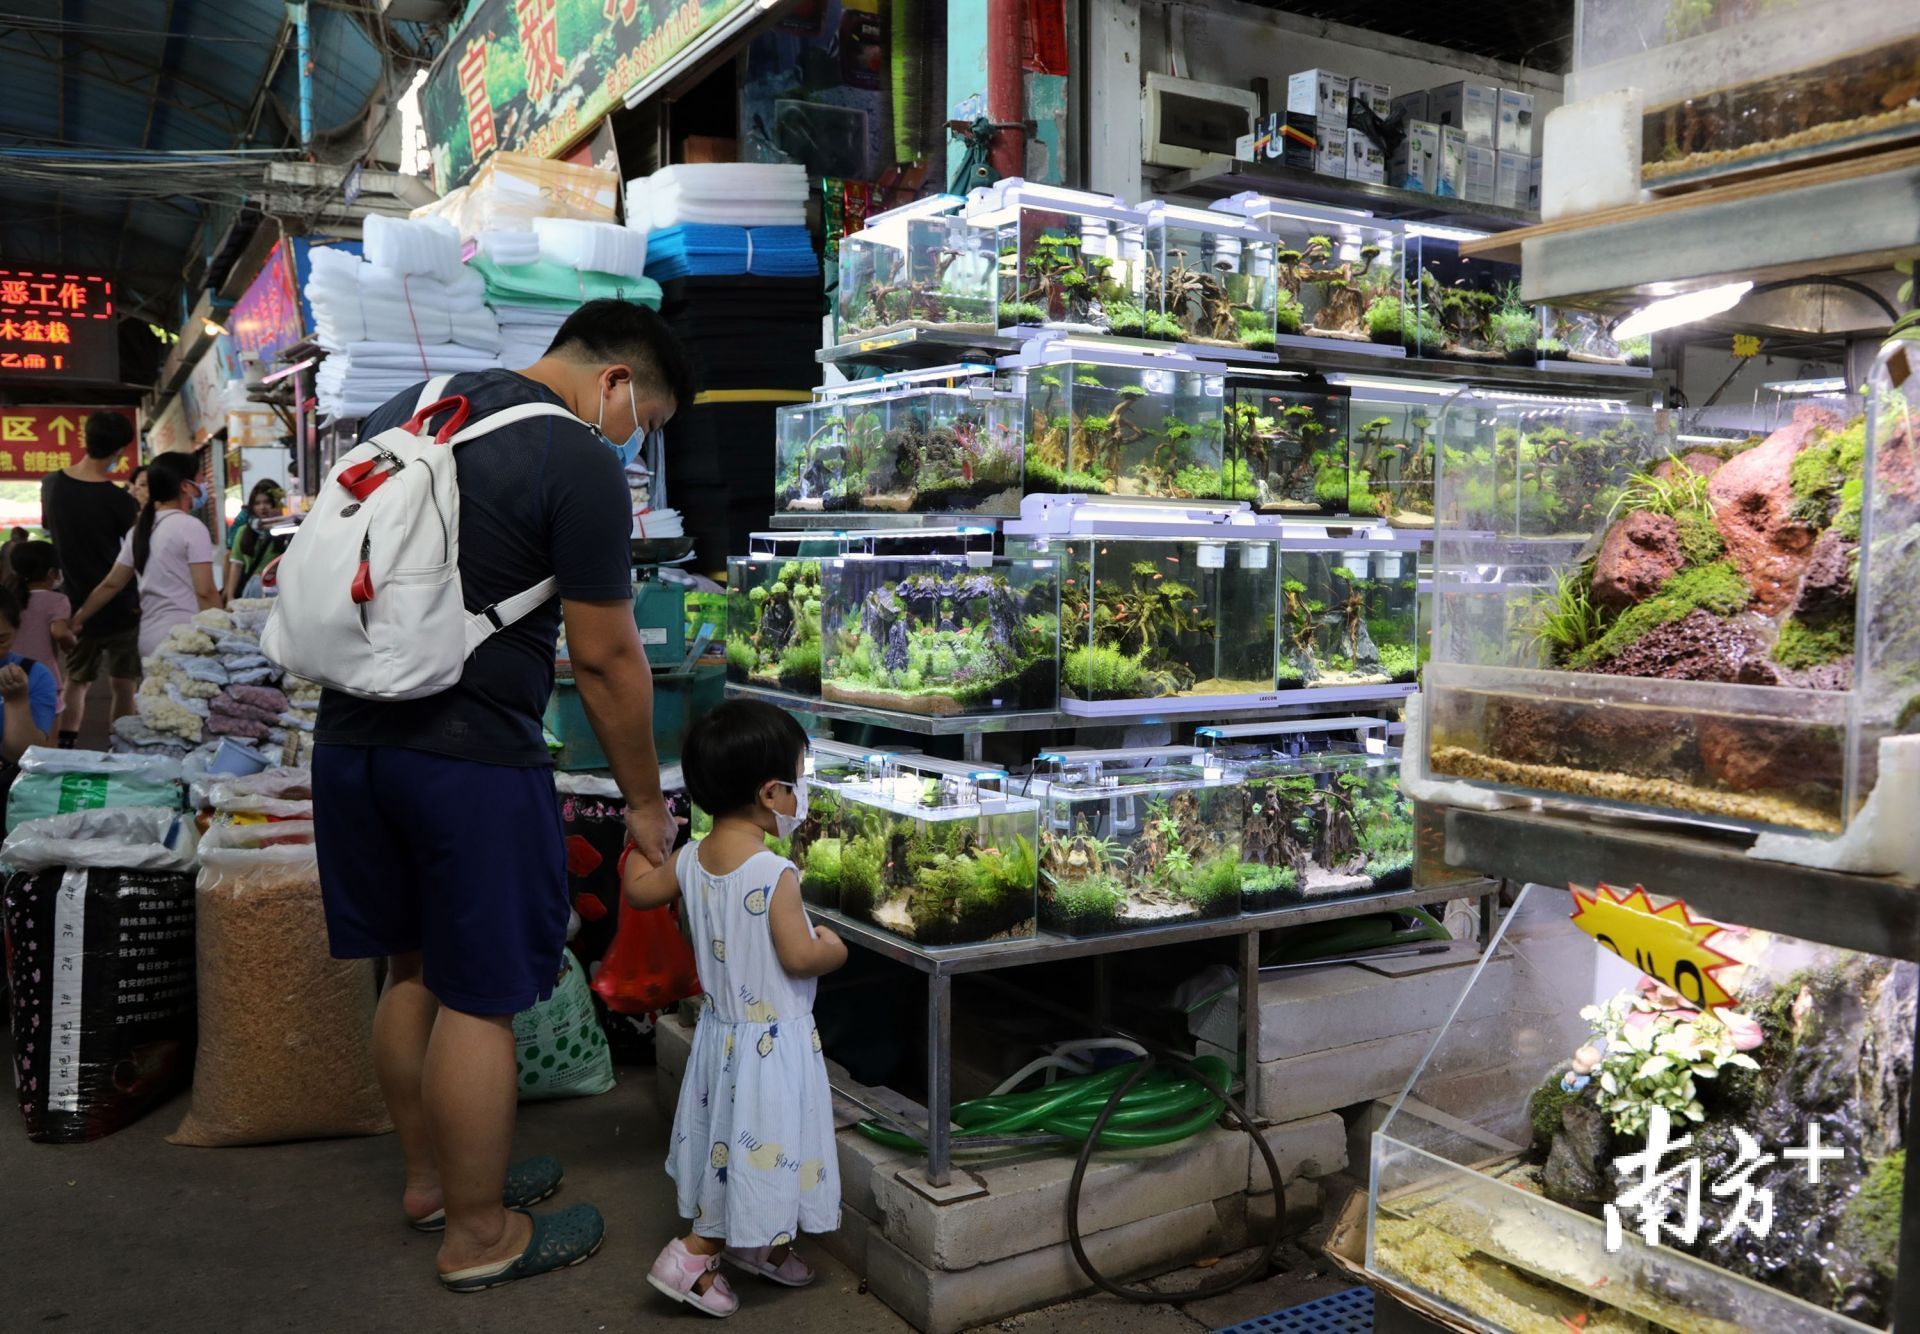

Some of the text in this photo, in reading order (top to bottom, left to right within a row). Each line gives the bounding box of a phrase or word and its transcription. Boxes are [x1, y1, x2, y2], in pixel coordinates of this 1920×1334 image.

[0, 280, 87, 309] 恶工作
[2, 415, 39, 442] 区
[66, 886, 77, 900] 4#
[62, 923, 74, 938] 3#
[61, 956, 73, 971] 2#
[61, 993, 72, 1006] 1#
